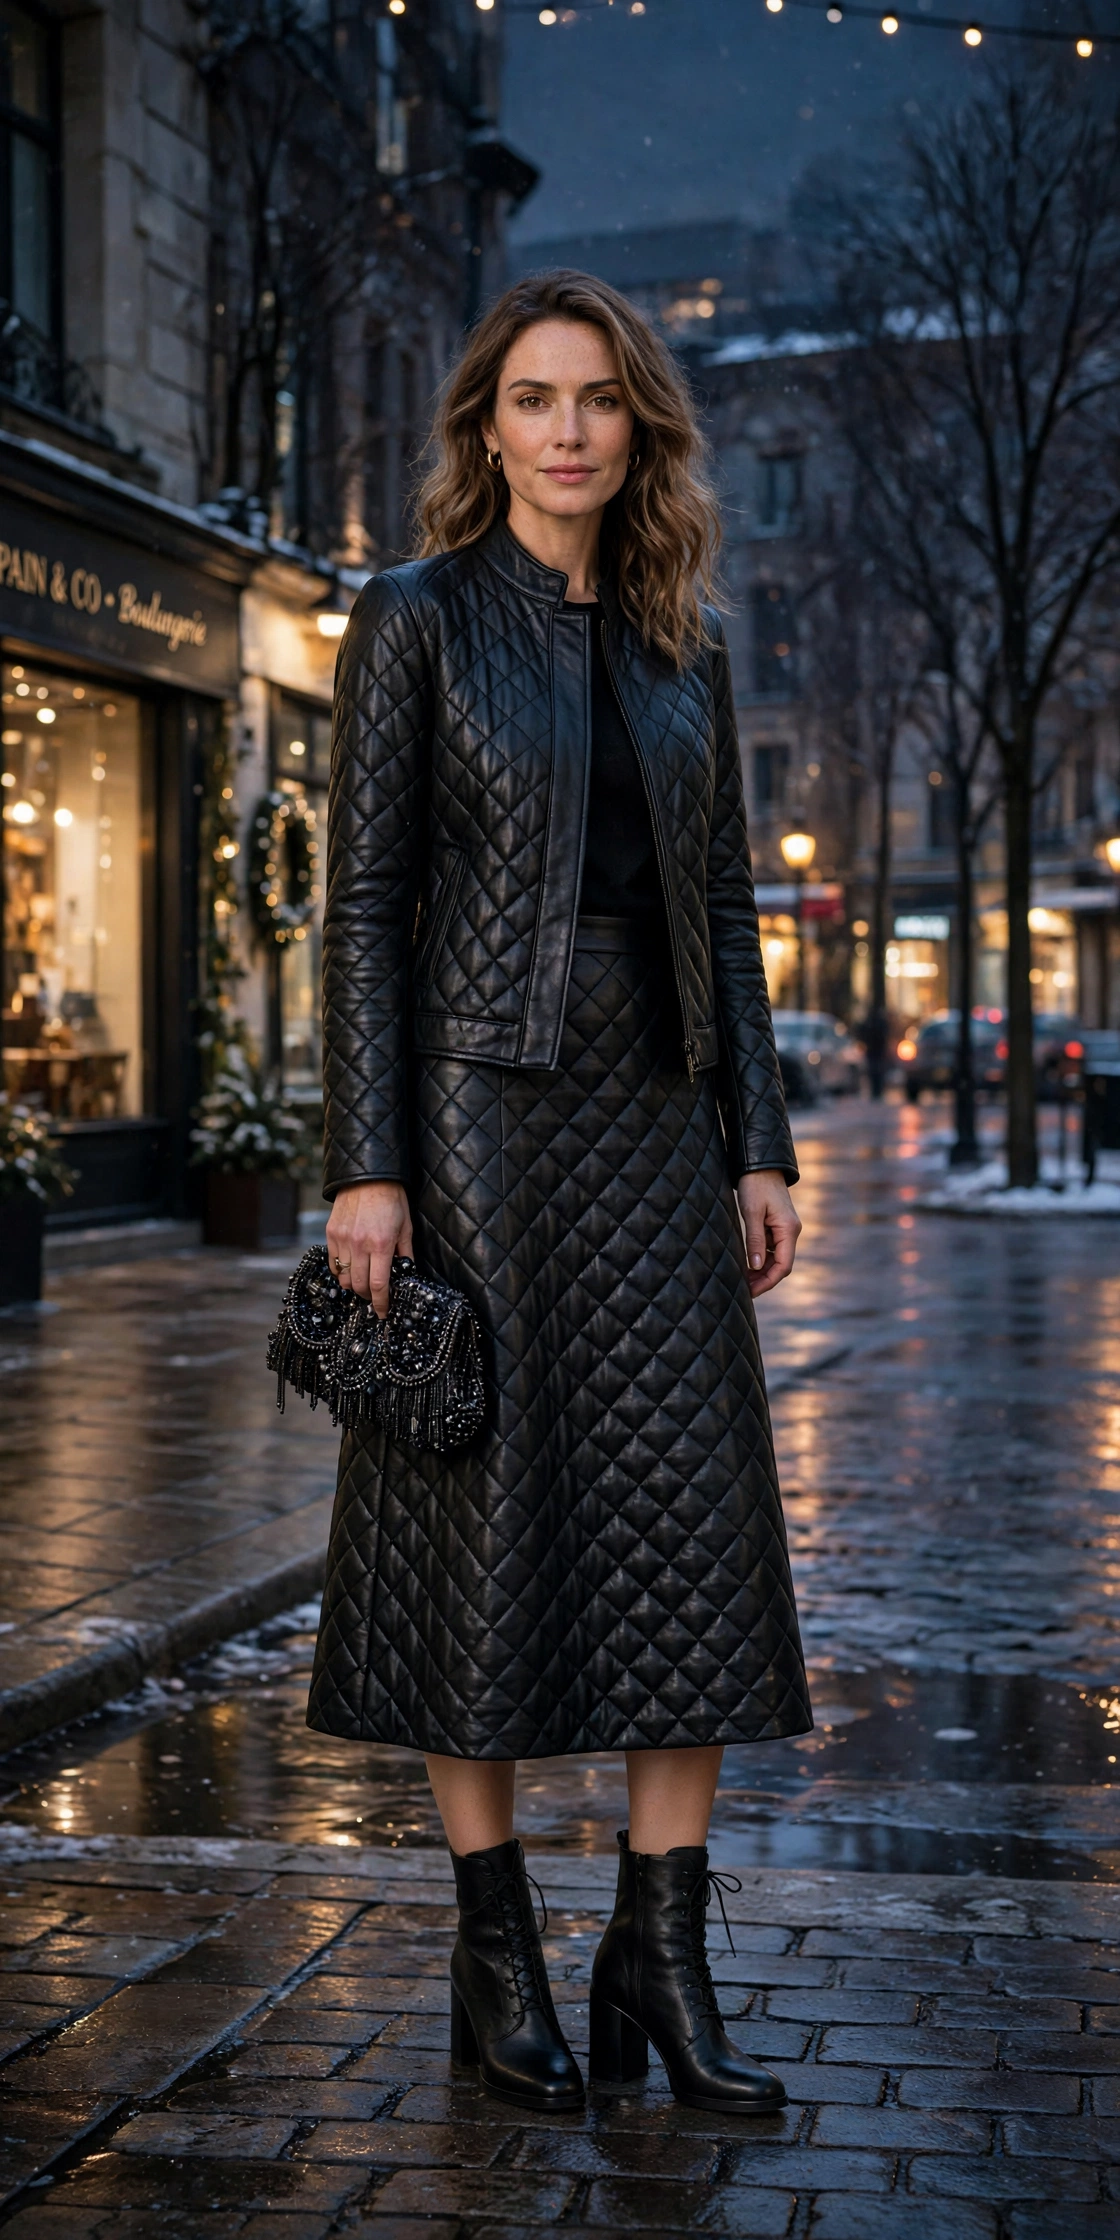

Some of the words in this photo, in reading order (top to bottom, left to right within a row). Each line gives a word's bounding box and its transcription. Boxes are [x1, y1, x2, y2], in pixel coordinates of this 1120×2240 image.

[0, 541, 47, 597] PAIN
[50, 560, 68, 605] &
[70, 568, 102, 615] CO
